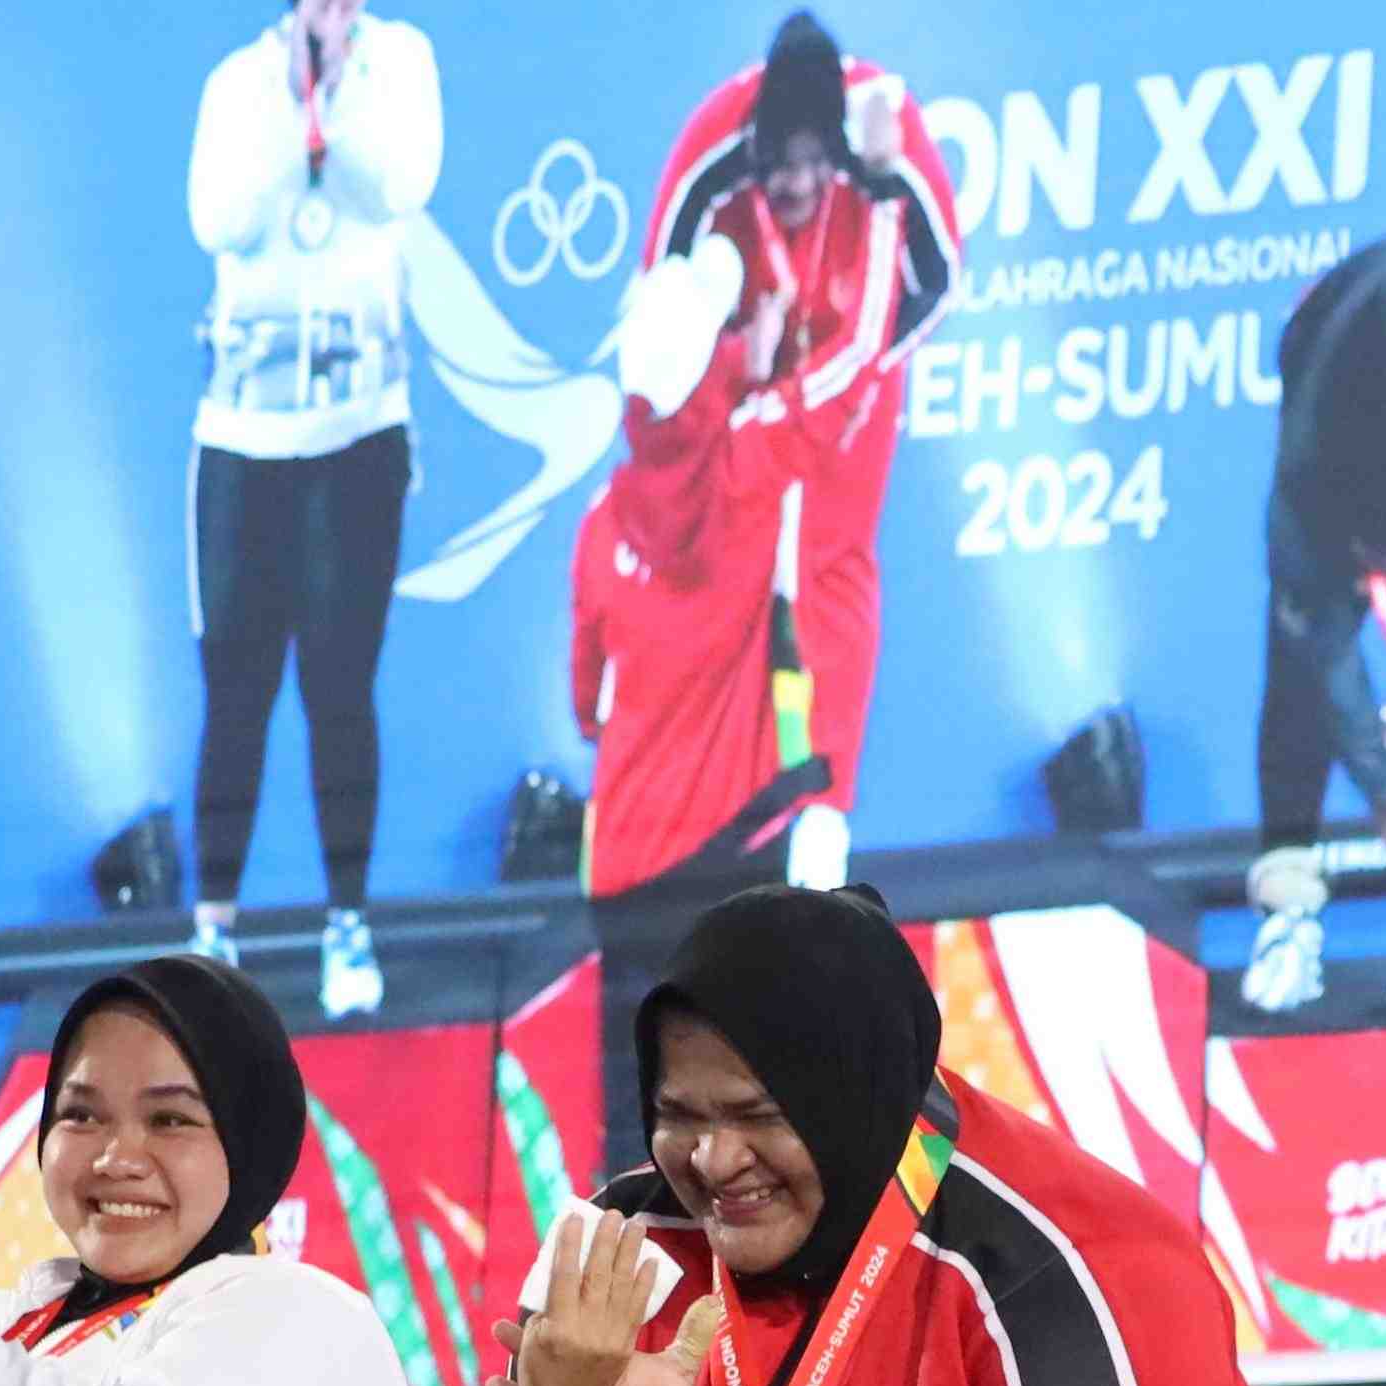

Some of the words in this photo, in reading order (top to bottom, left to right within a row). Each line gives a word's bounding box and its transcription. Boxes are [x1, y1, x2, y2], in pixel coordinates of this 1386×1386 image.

[1125, 48, 1375, 225] XXI
[954, 444, 1169, 557] 2024
[860, 1244, 890, 1289] 2024
